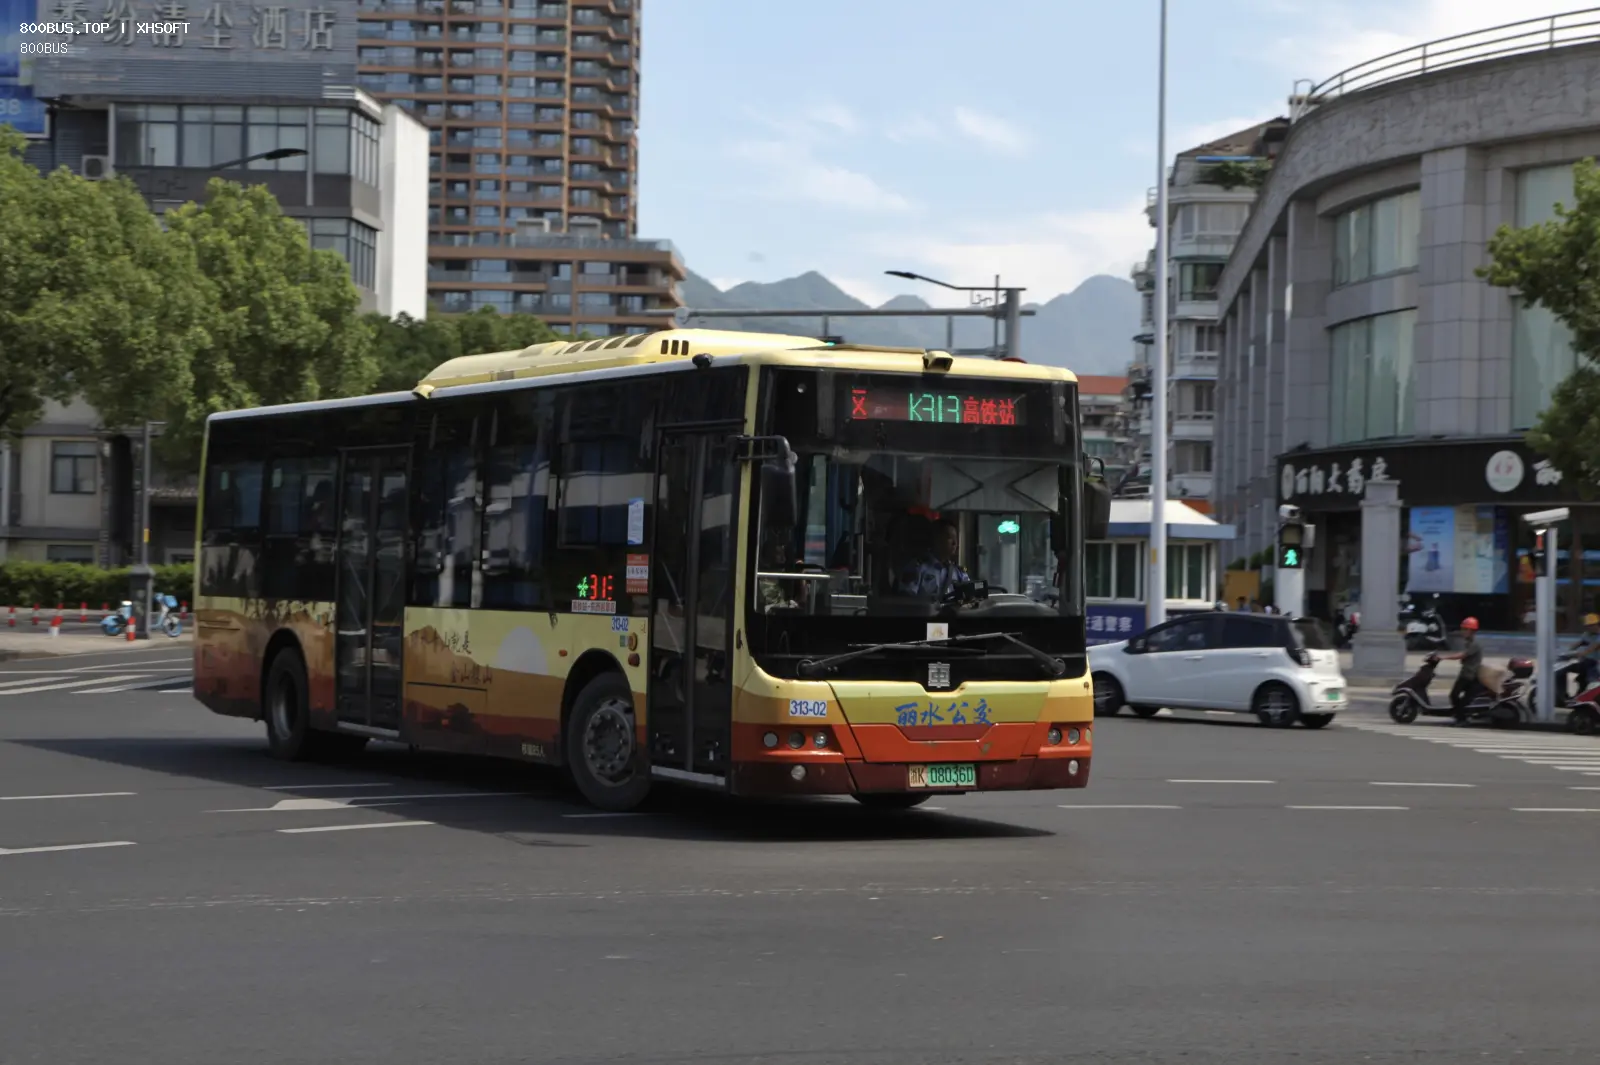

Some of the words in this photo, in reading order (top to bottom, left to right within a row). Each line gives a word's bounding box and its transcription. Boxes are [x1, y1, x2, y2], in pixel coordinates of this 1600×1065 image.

[963, 396, 1015, 425] 高铁站
[611, 616, 629, 632] 313-02
[790, 699, 827, 716] 313-02
[894, 697, 993, 728] 丽水公交
